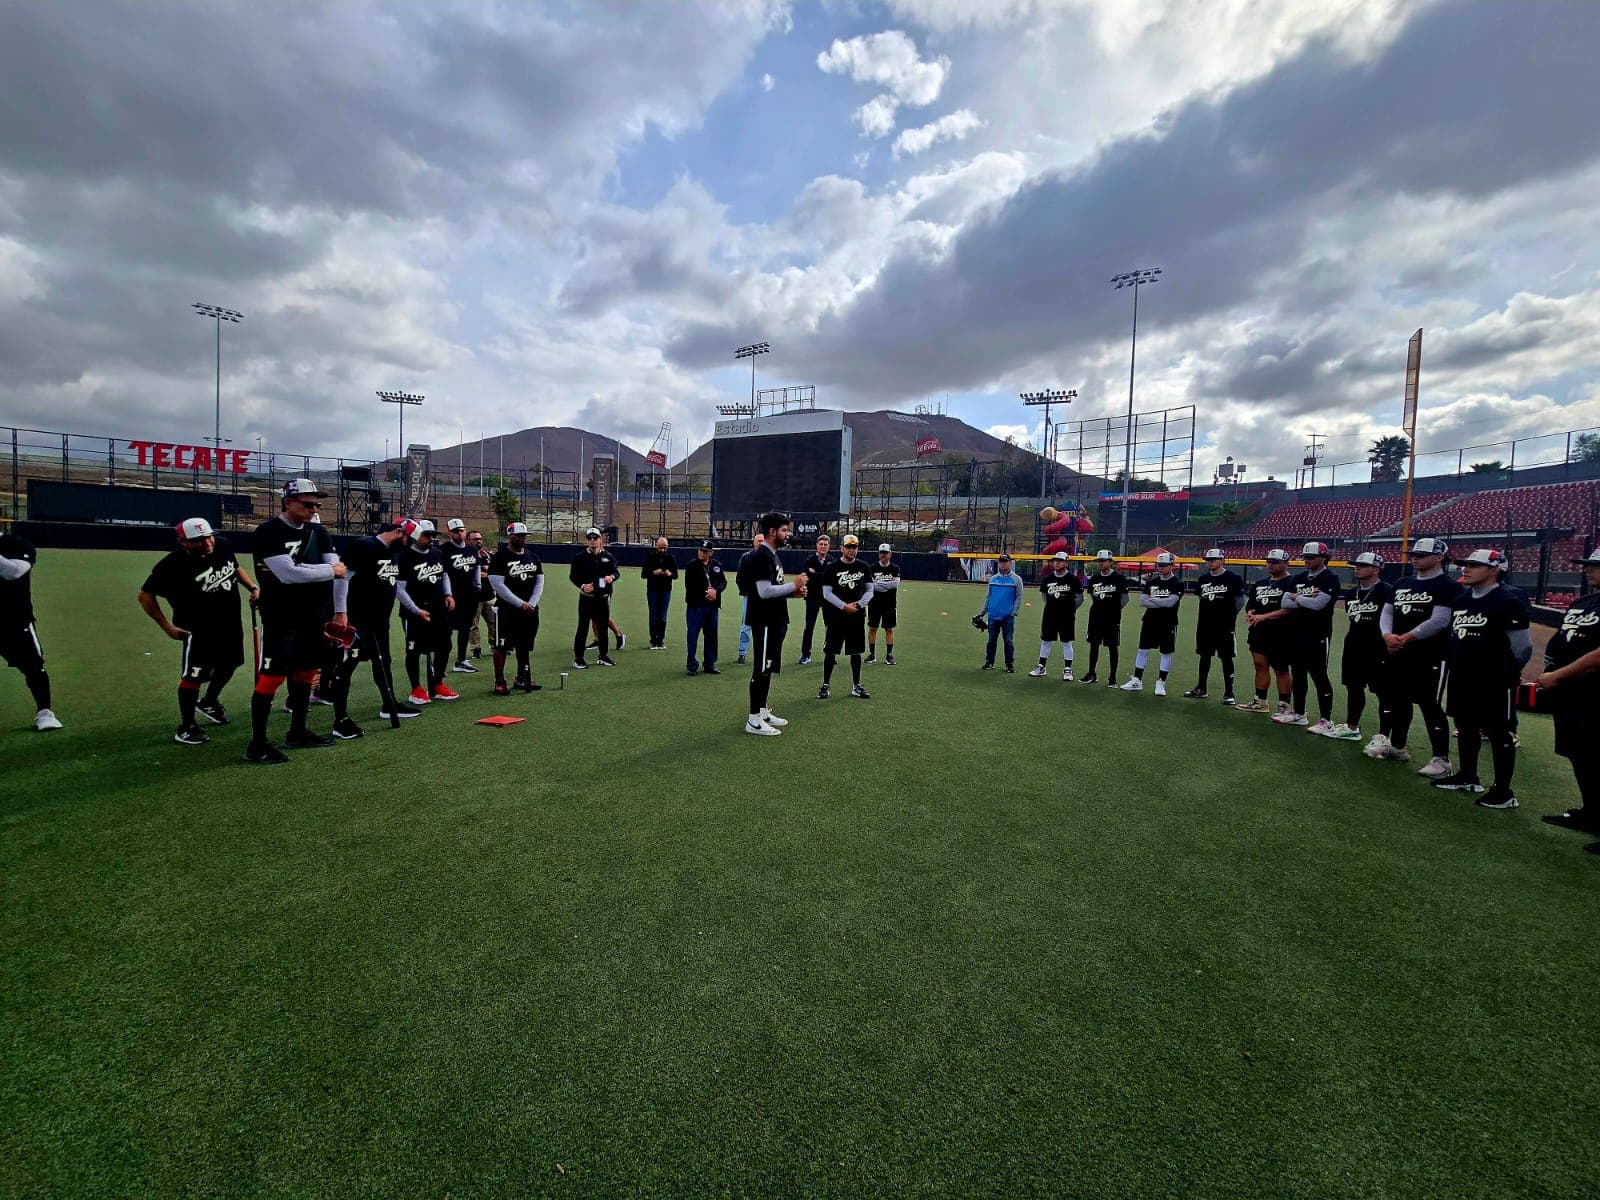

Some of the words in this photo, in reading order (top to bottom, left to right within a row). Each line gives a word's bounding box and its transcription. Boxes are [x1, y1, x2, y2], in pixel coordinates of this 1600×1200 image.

[715, 421, 760, 435] Estadio
[128, 440, 250, 474] TECATE
[451, 554, 476, 569] Toros
[507, 560, 537, 577] Toros
[195, 561, 235, 592] Toros
[414, 562, 444, 581] Toros
[836, 571, 865, 585] Toros
[1201, 582, 1228, 600] Toros
[1255, 585, 1283, 602] Toros
[1394, 589, 1432, 606] Toros
[1347, 600, 1379, 617] Toros
[1453, 609, 1488, 632] Toros
